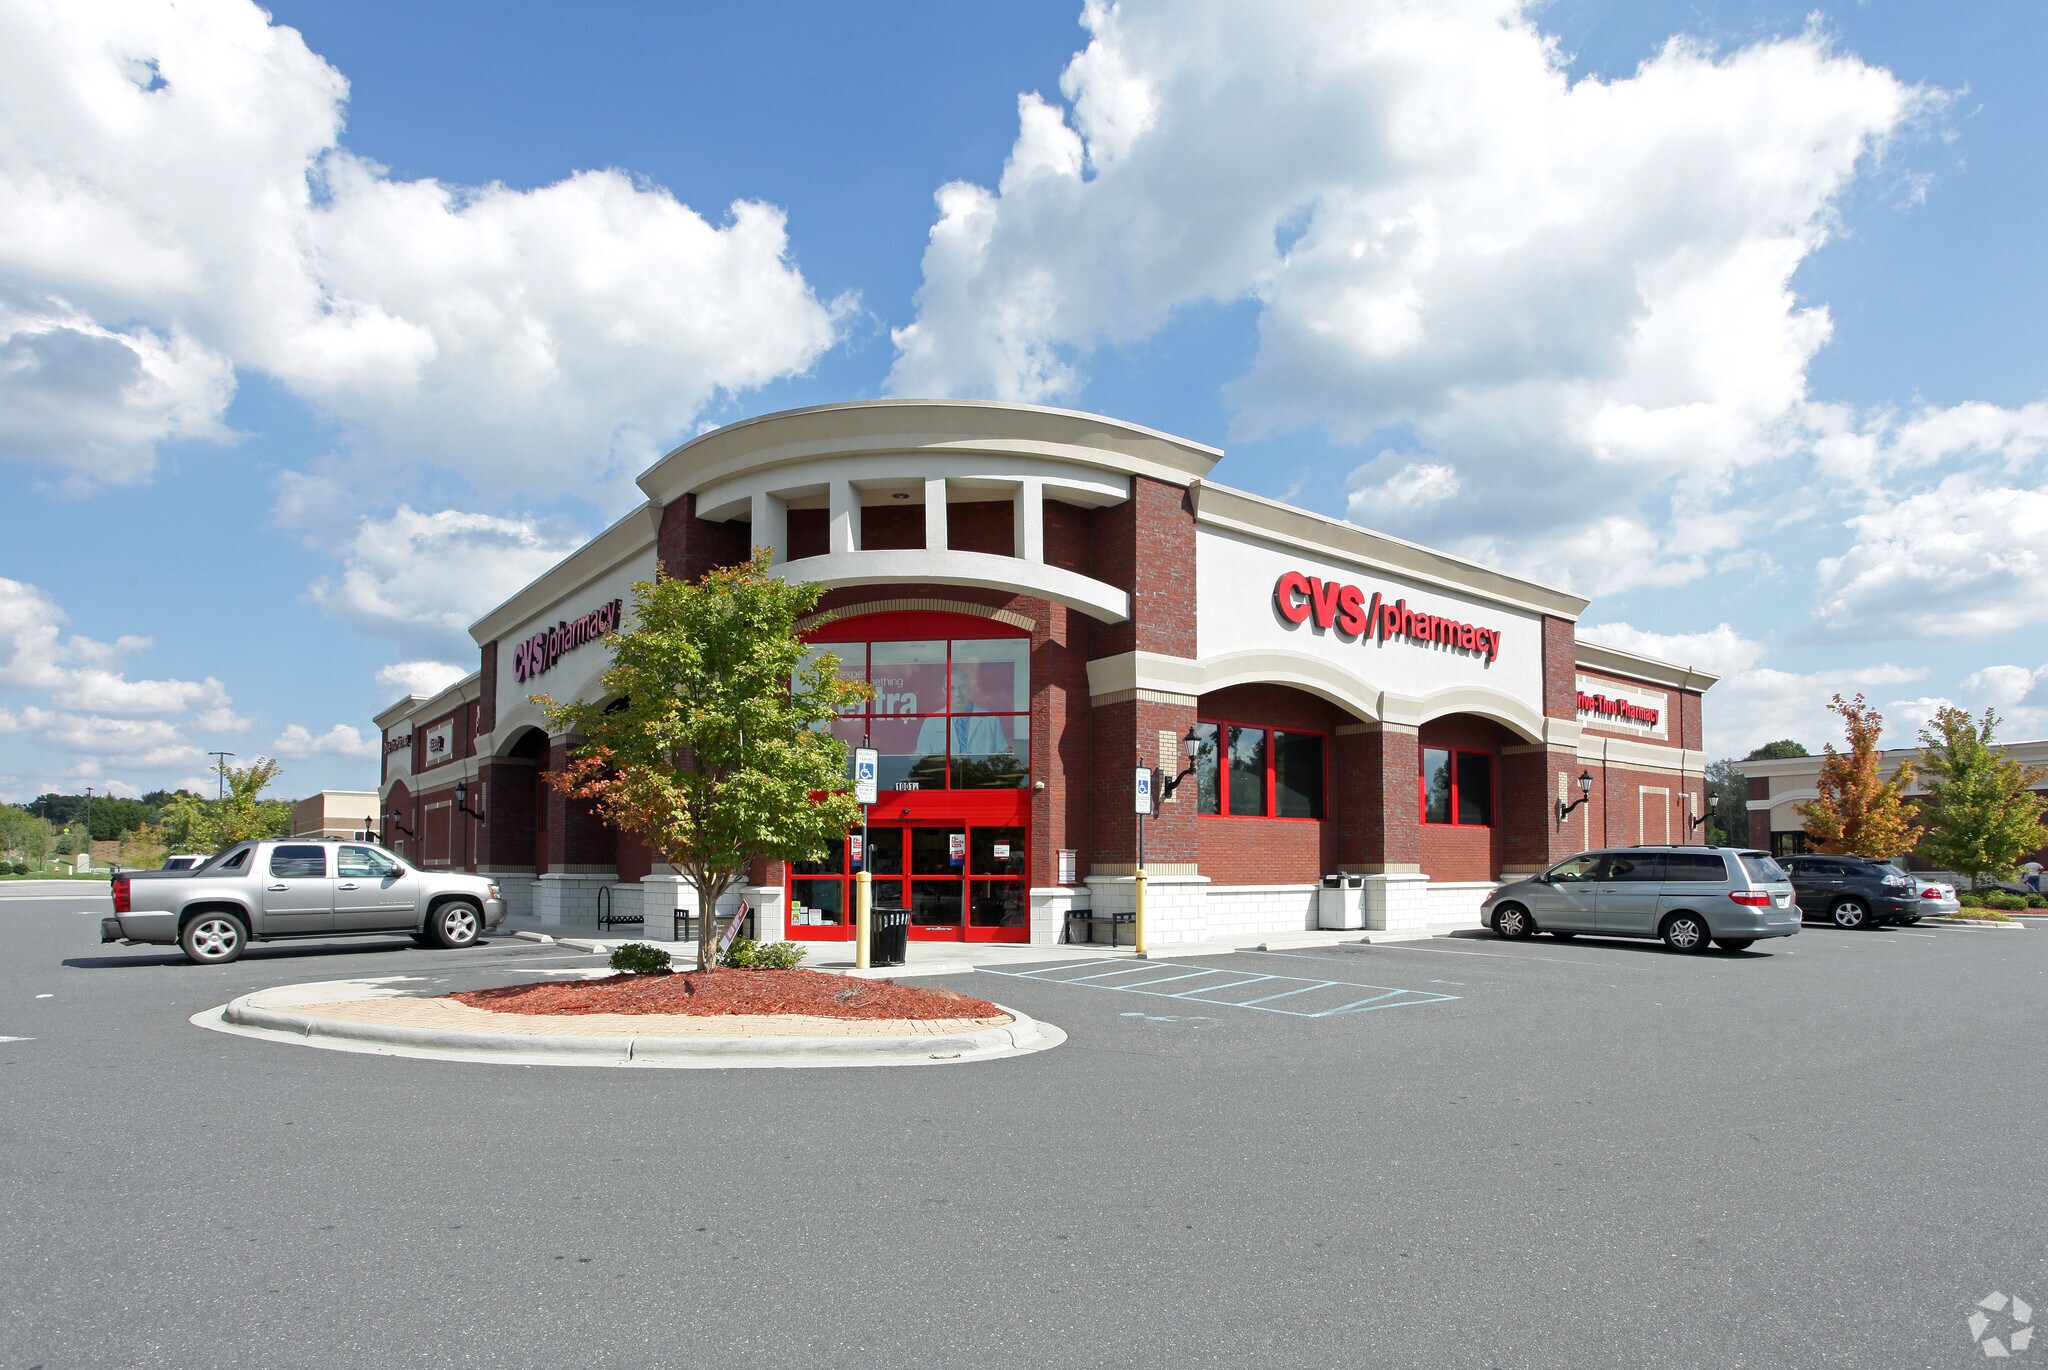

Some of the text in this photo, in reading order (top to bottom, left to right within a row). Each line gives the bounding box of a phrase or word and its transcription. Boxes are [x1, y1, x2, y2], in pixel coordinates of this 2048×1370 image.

[513, 599, 620, 682] CVS/pharmacy
[1275, 571, 1501, 662] CVS/pharmacy
[840, 671, 872, 681] expec
[1575, 691, 1659, 725] rive-Thru Pharmacy
